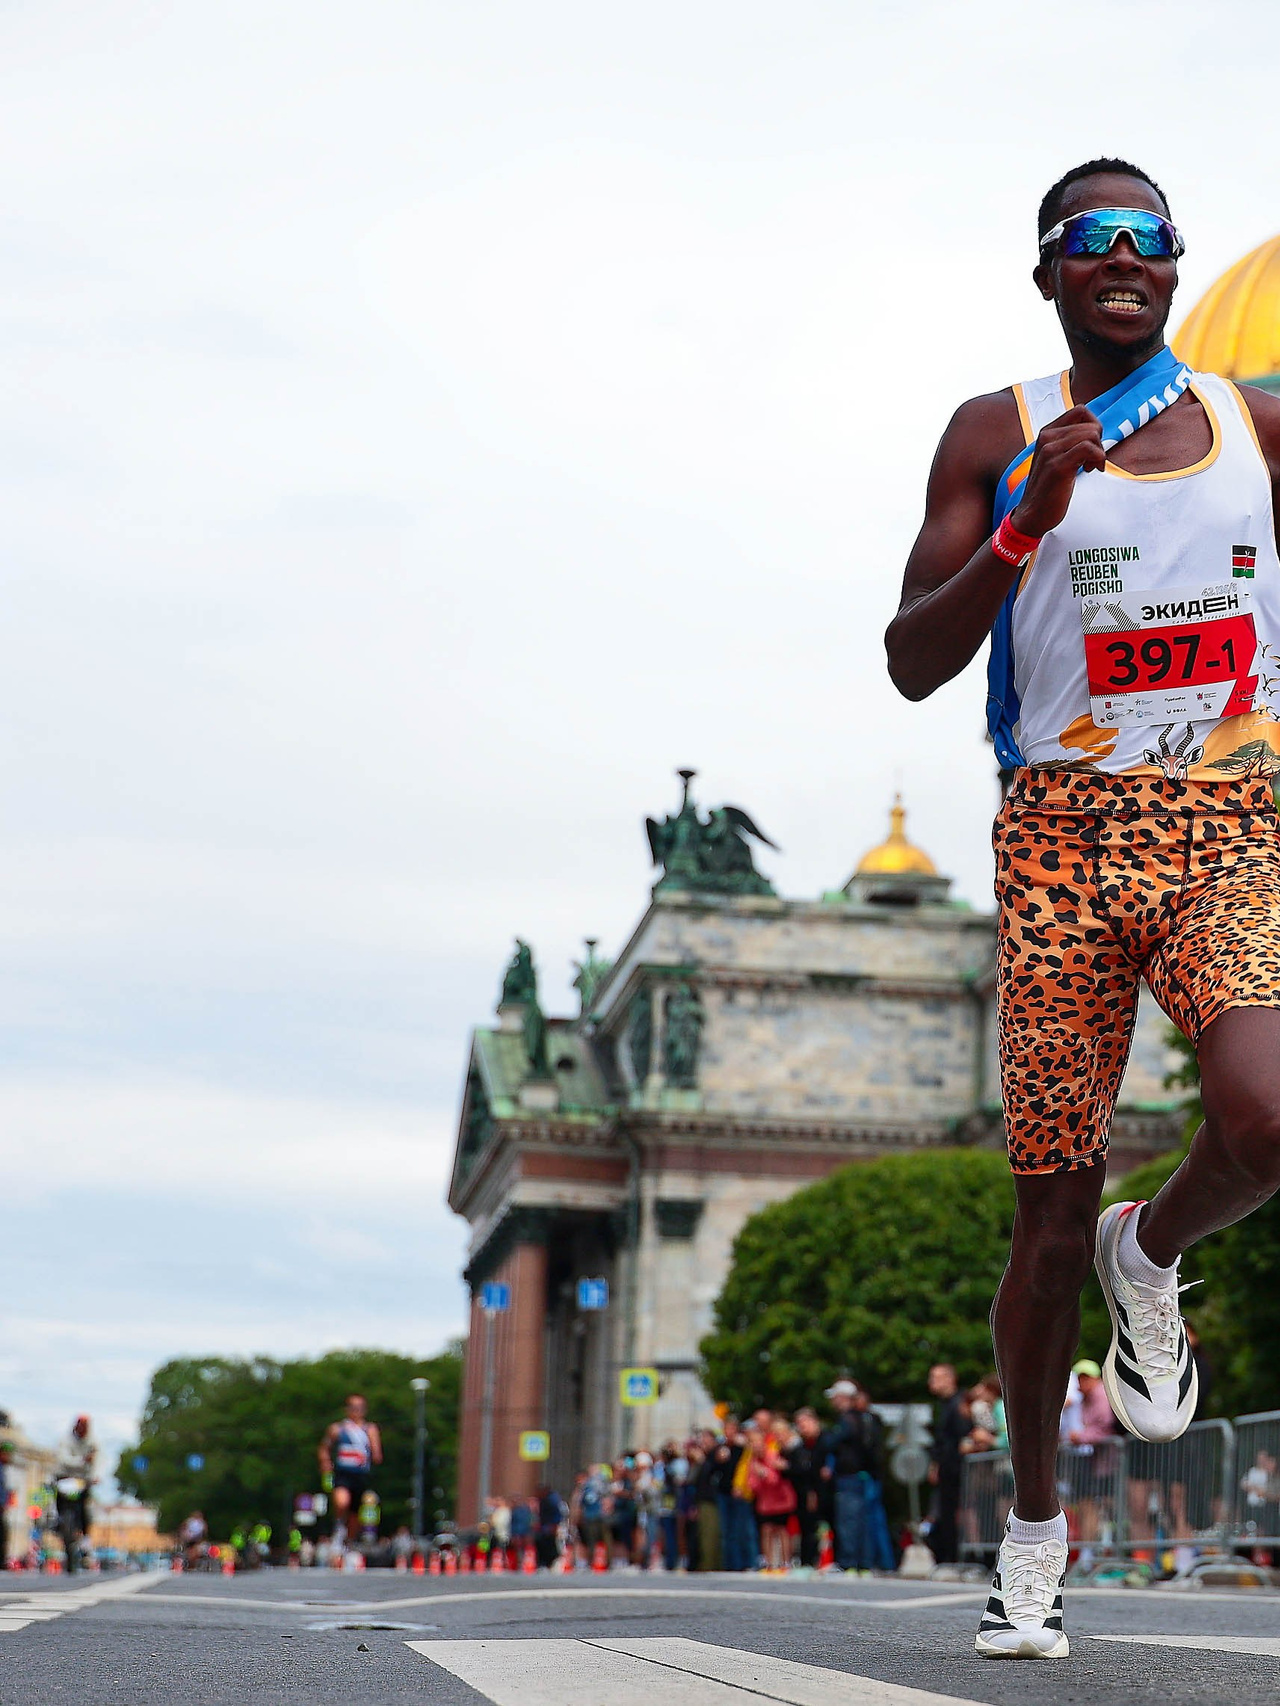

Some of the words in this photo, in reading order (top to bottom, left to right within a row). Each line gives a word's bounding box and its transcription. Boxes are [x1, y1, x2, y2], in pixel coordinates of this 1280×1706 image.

[1068, 546, 1140, 566] LONGOSIWA
[1070, 563, 1119, 582] REUBEN
[1072, 580, 1123, 598] POGISHO
[1140, 593, 1239, 621] ЭКИДЕН
[1105, 633, 1237, 687] 397-1
